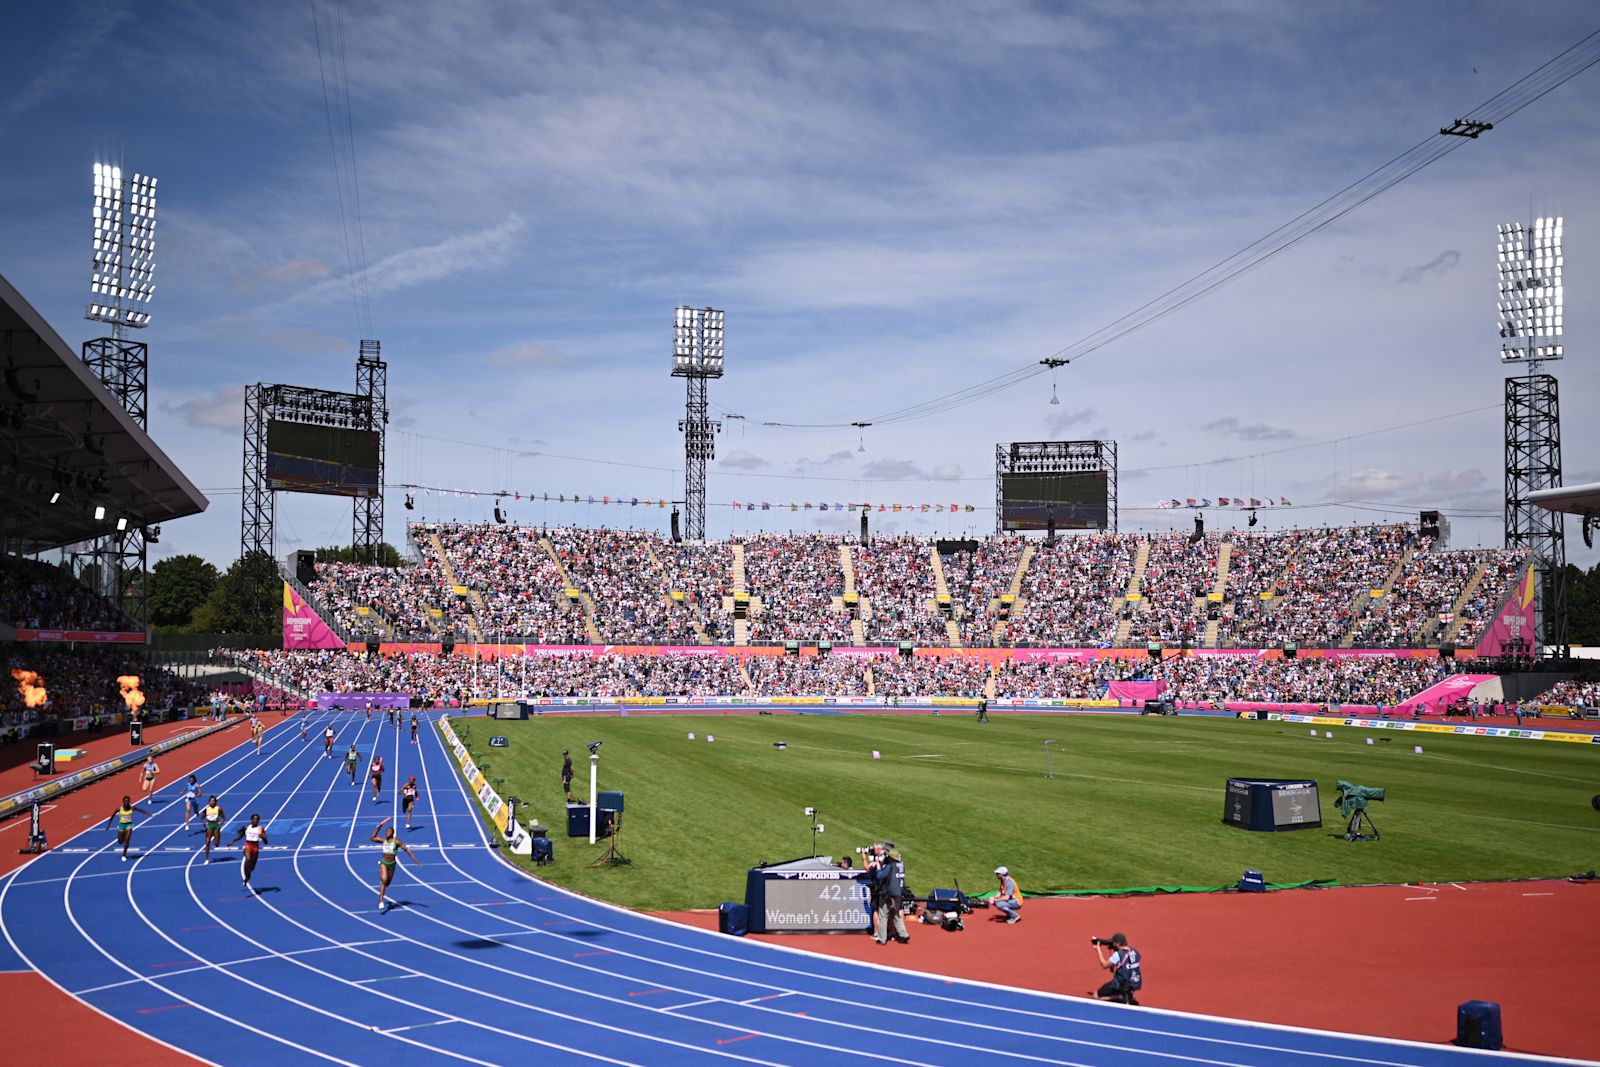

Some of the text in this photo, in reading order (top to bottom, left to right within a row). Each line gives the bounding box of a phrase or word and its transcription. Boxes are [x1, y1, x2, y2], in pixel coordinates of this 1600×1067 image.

[798, 872, 840, 880] LONGINES
[819, 884, 871, 901] 42.10
[766, 909, 871, 924] Women's 4x100m
